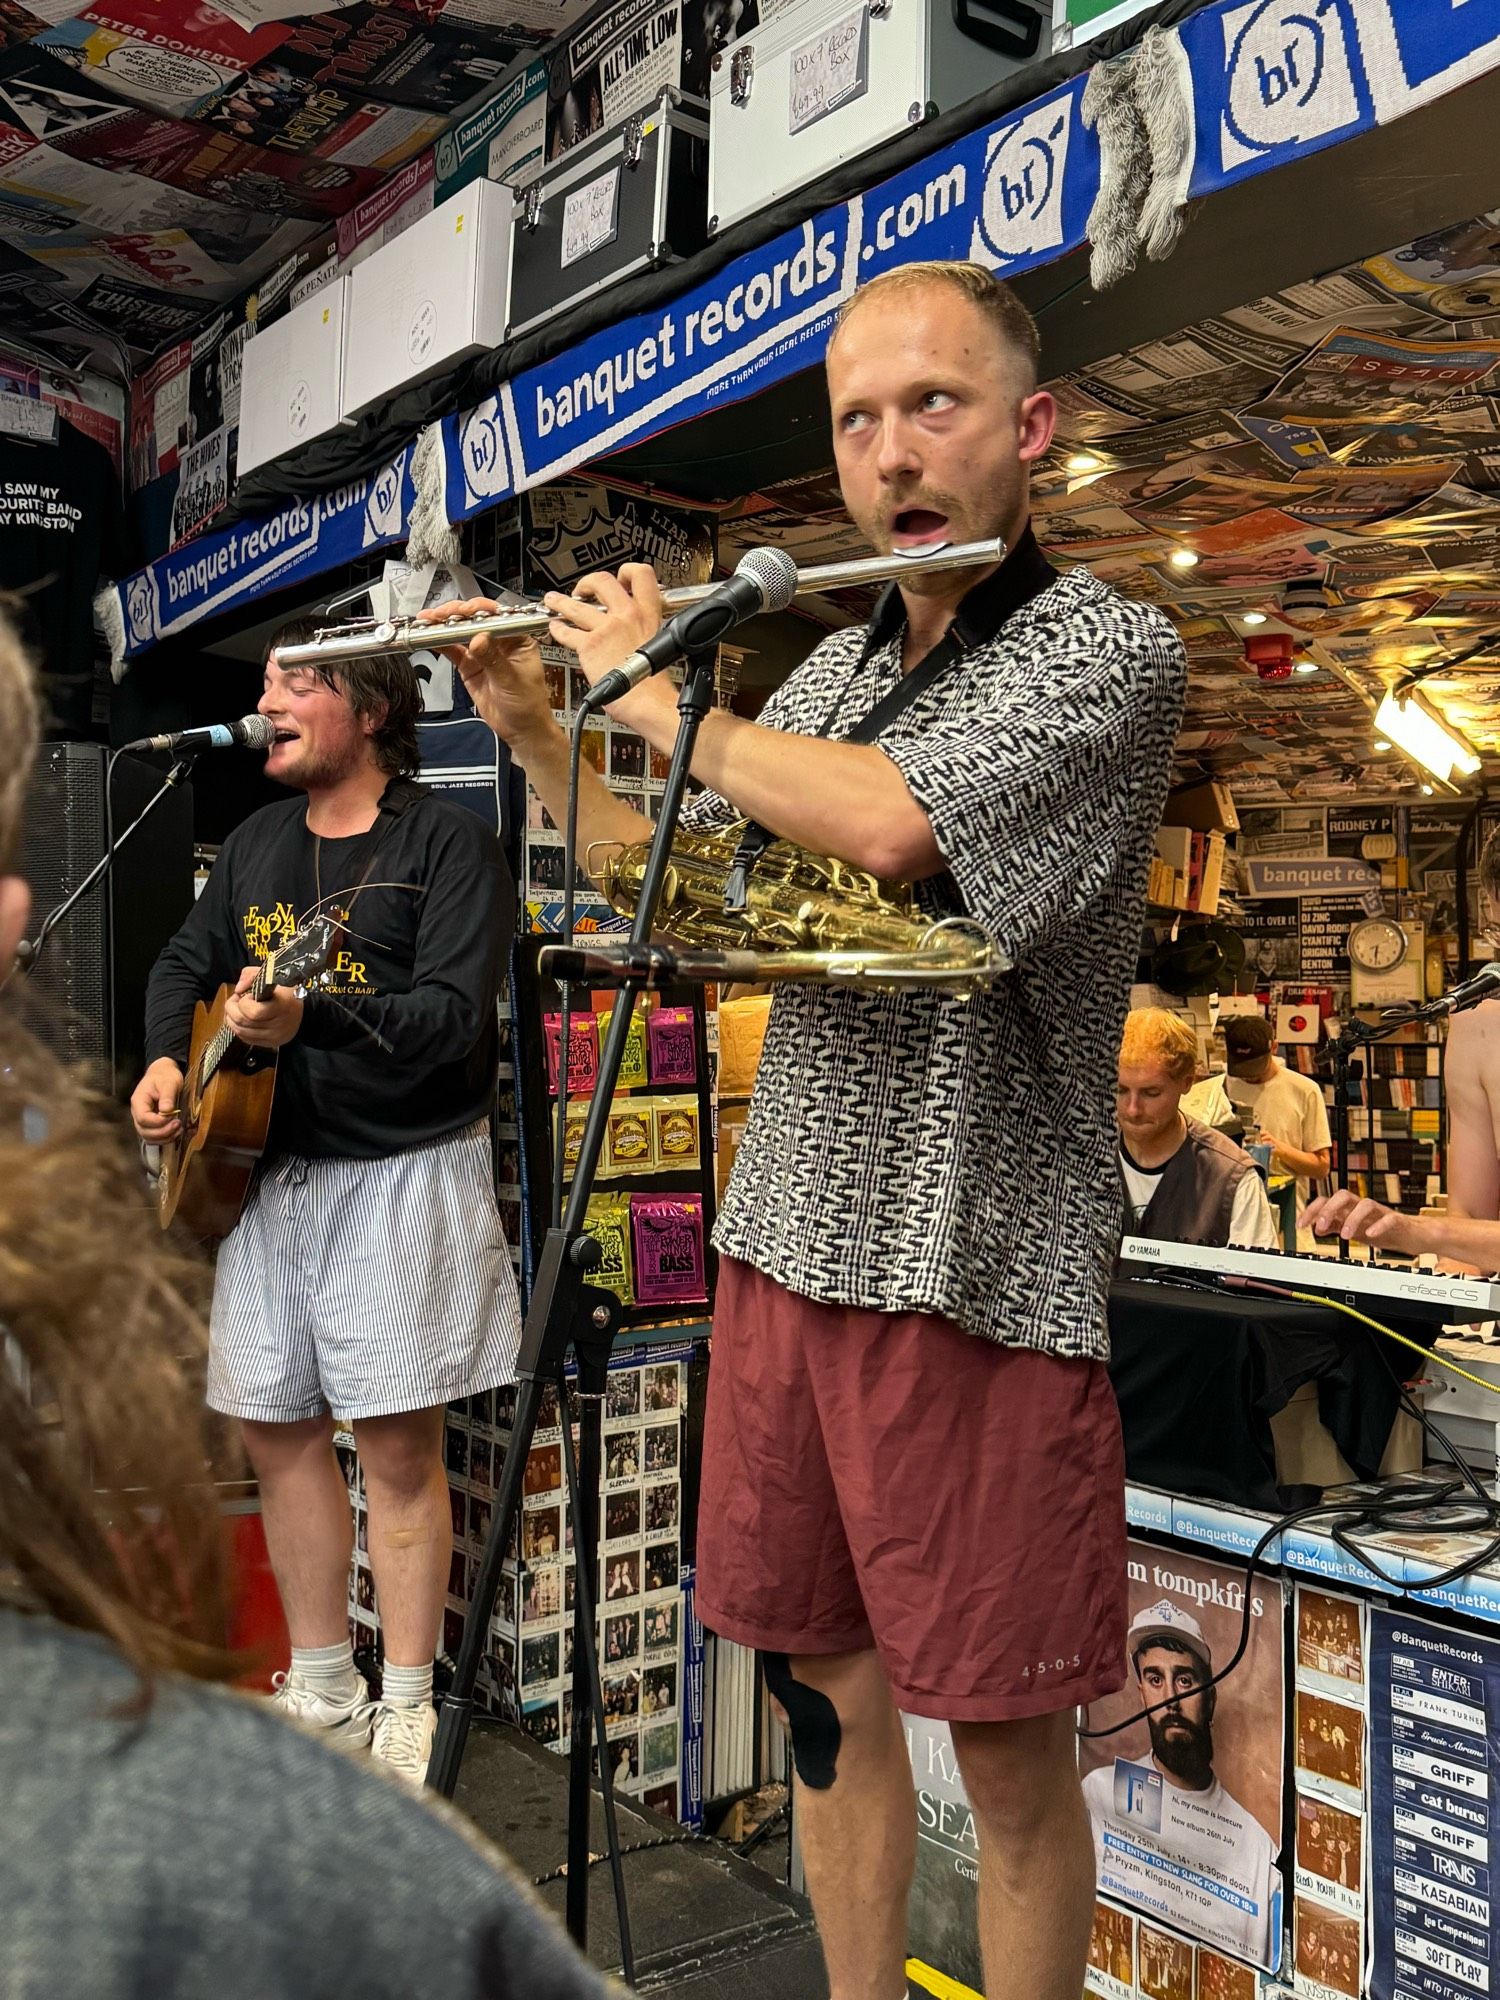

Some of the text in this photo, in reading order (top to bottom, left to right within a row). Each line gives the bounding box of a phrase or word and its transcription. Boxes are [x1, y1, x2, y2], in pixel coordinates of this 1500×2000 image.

[84, 13, 249, 69] PETER DOHERTY
[576, 18, 613, 60] banquet
[603, 50, 622, 93] ALL
[623, 23, 651, 73] TIME
[651, 7, 678, 51] LOW
[828, 26, 857, 56] RECORD
[461, 69, 546, 146] banquet records .com
[360, 198, 387, 222] banquet
[388, 173, 415, 203] records
[416, 158, 434, 178] .com
[536, 163, 966, 438] banquet records .com
[707, 380, 729, 400] MORE
[731, 366, 753, 387] THAN
[753, 352, 774, 372] YOUR
[775, 337, 798, 358] LOCAL
[800, 316, 833, 343] RECORD
[186, 434, 221, 479] THE HIVES
[5, 482, 60, 500] SAW MY
[47, 503, 82, 520] BAND
[652, 507, 689, 546] LIAR
[167, 477, 368, 603] banquet records .com
[1329, 817, 1391, 832] RODNEY P
[1263, 865, 1342, 887] banquet
[1267, 915, 1285, 927] OVER
[1301, 912, 1331, 923] DJ ZINC
[1301, 924, 1325, 935] DAVID
[1301, 935, 1342, 947] CYANTIFIC
[1301, 947, 1337, 958] ORIGINAL
[1301, 959, 1334, 970] BENTON
[659, 1256, 695, 1273] BASS
[1136, 1245, 1161, 1257] YAMAHA
[1399, 1283, 1480, 1302] reface CS
[1153, 1566, 1264, 1617] tompkins
[1391, 1630, 1484, 1665] @BanquetRecords
[1432, 1667, 1467, 1687] ENTER
[1419, 1700, 1448, 1715] FRANK
[1452, 1709, 1485, 1727] TURNER
[1420, 1730, 1448, 1747] Gracie
[1447, 1741, 1485, 1759] Abrams
[1430, 1764, 1475, 1787] GRIFF
[1181, 1801, 1190, 1812] my
[1191, 1803, 1209, 1816] name
[1210, 1808, 1216, 1818] is
[1217, 1812, 1243, 1830] insecure
[1420, 1792, 1486, 1826] cat burns
[1171, 1816, 1236, 1848] New album 26th July
[1430, 1825, 1475, 1850] GRIFF
[1103, 1819, 1136, 1843] Thursday
[1137, 1835, 1155, 1850] 25th
[1198, 1861, 1228, 1884] 8:30pm
[1229, 1877, 1251, 1895] doors
[1108, 1836, 1126, 1851] FREE
[1126, 1843, 1150, 1862] ENTRY
[1151, 1855, 1162, 1867] TO
[1162, 1861, 1180, 1875] NEW
[1181, 1869, 1203, 1888] SLANG
[1204, 1880, 1220, 1894] FOR
[1220, 1888, 1241, 1906] OVER
[1431, 1852, 1477, 1886] TRAVIS
[1115, 1854, 1143, 1876] Pryzm,
[1145, 1867, 1184, 1896] Kingston,
[1101, 1874, 1169, 1913] @BanquetRecords
[1421, 1881, 1487, 1920] KASABIAN
[1425, 1946, 1482, 1983] SOFT PLAY
[1423, 1977, 1442, 1994] INTO
